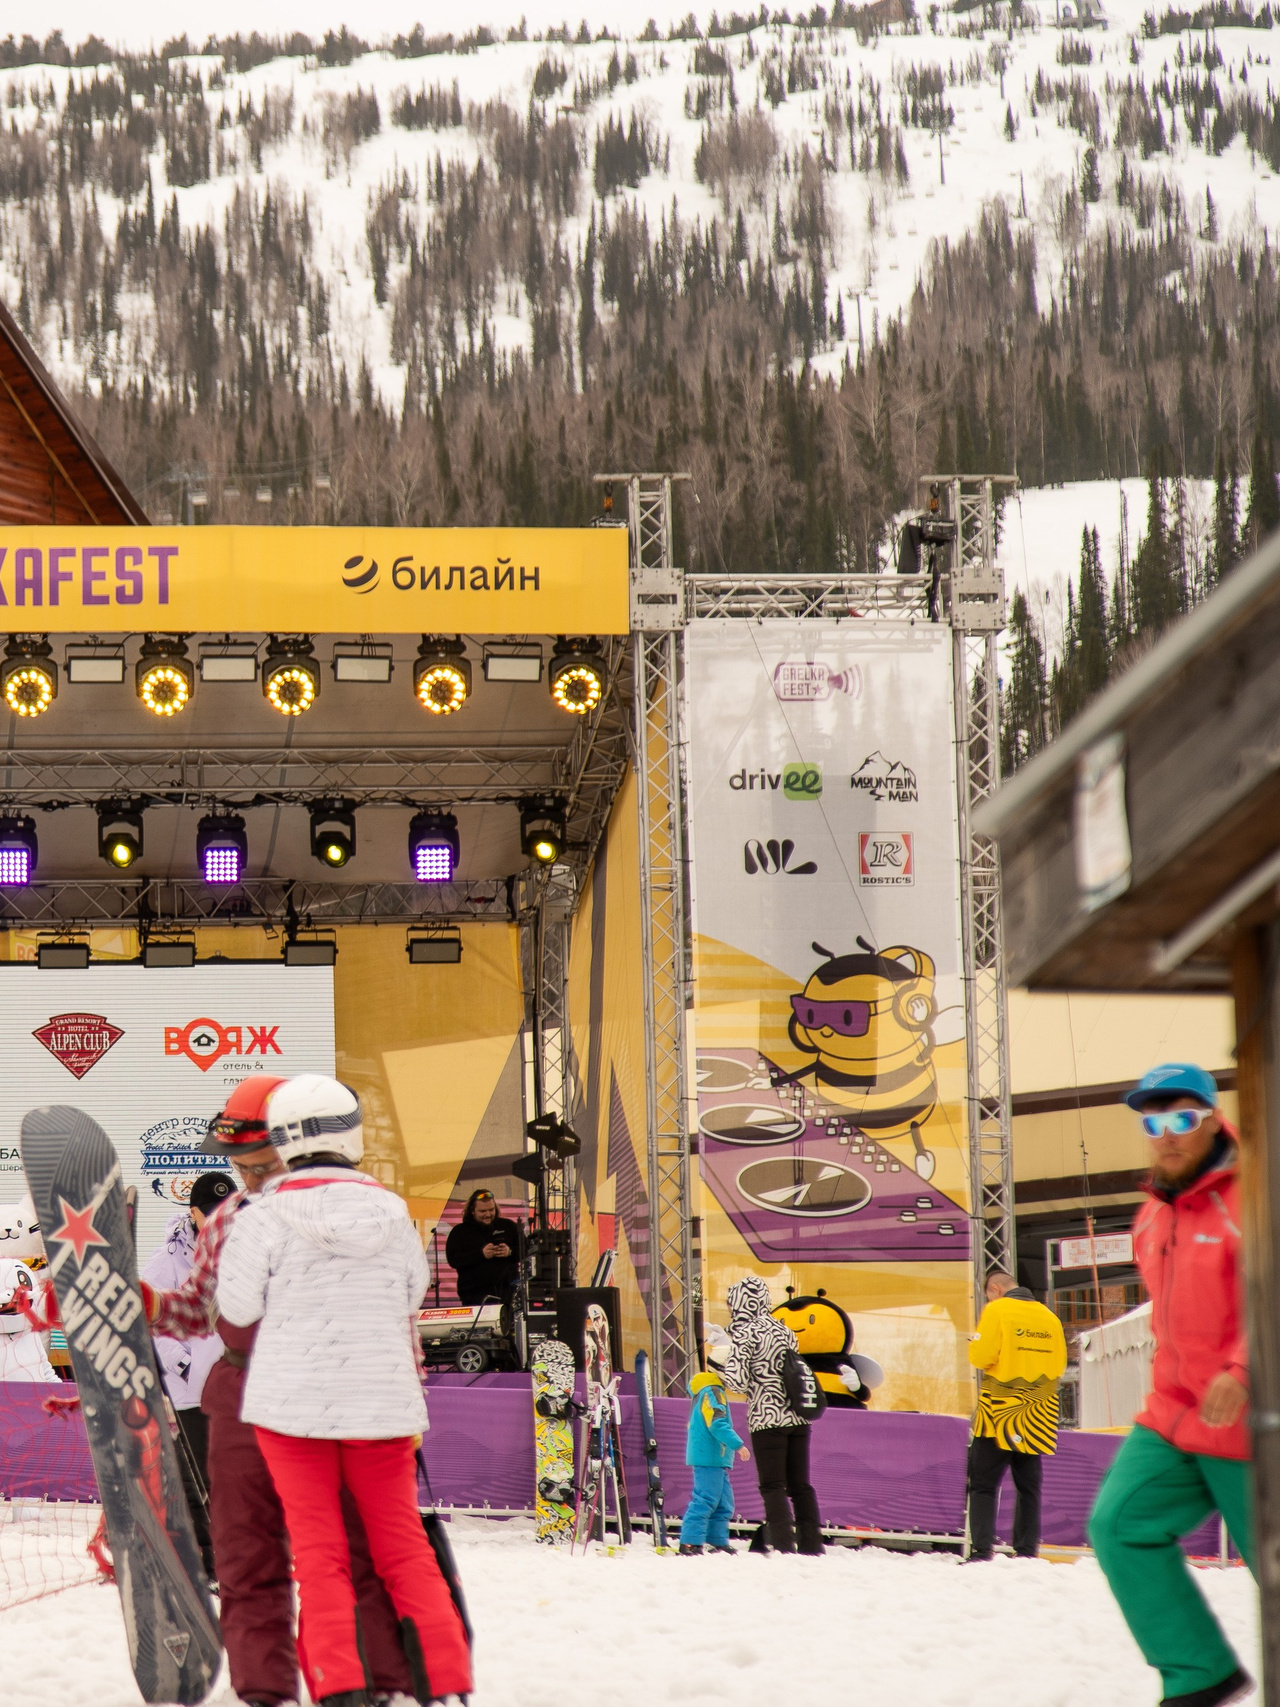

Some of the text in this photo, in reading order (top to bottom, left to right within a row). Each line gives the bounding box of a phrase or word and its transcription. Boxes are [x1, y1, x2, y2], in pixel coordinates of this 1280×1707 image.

[392, 556, 540, 592] билайн
[782, 667, 825, 681] GRELKA
[783, 682, 811, 697] FEST
[729, 768, 822, 794] drivee
[850, 776, 917, 790] MOUNTAIN
[888, 790, 919, 803] MAN
[862, 876, 912, 885] ROSTIC'S
[55, 1018, 101, 1026] GRAND RESORT
[50, 1031, 111, 1051] ALPEN CLUB
[164, 1018, 283, 1066] ВОЯЖ
[255, 1061, 264, 1070] &
[0, 1148, 24, 1160] БА
[148, 1155, 226, 1165] ПОЛИТЕХ
[76, 1252, 143, 1334] RED
[61, 1286, 155, 1401] WINGS
